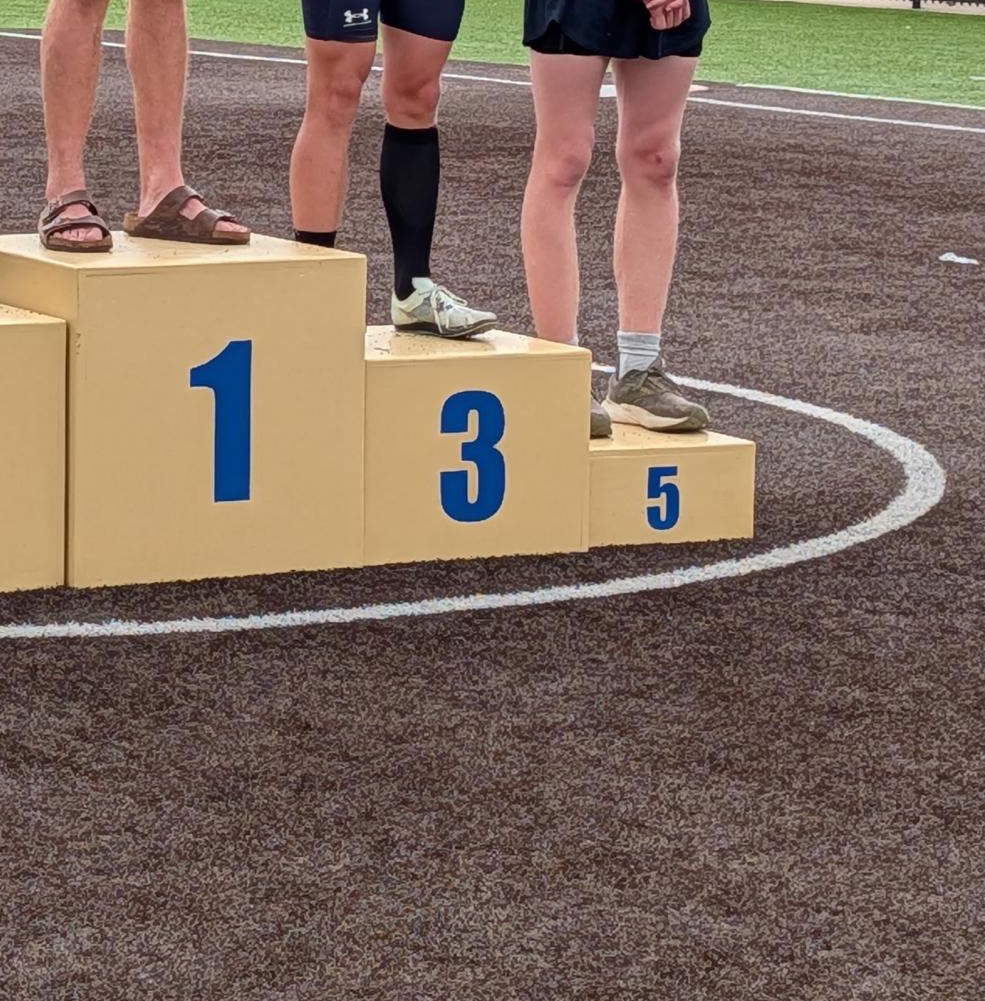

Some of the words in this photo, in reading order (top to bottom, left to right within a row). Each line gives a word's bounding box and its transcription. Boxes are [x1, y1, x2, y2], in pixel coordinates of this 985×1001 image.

[189, 339, 253, 503] 1
[440, 389, 506, 523] 3
[646, 465, 680, 531] 5
